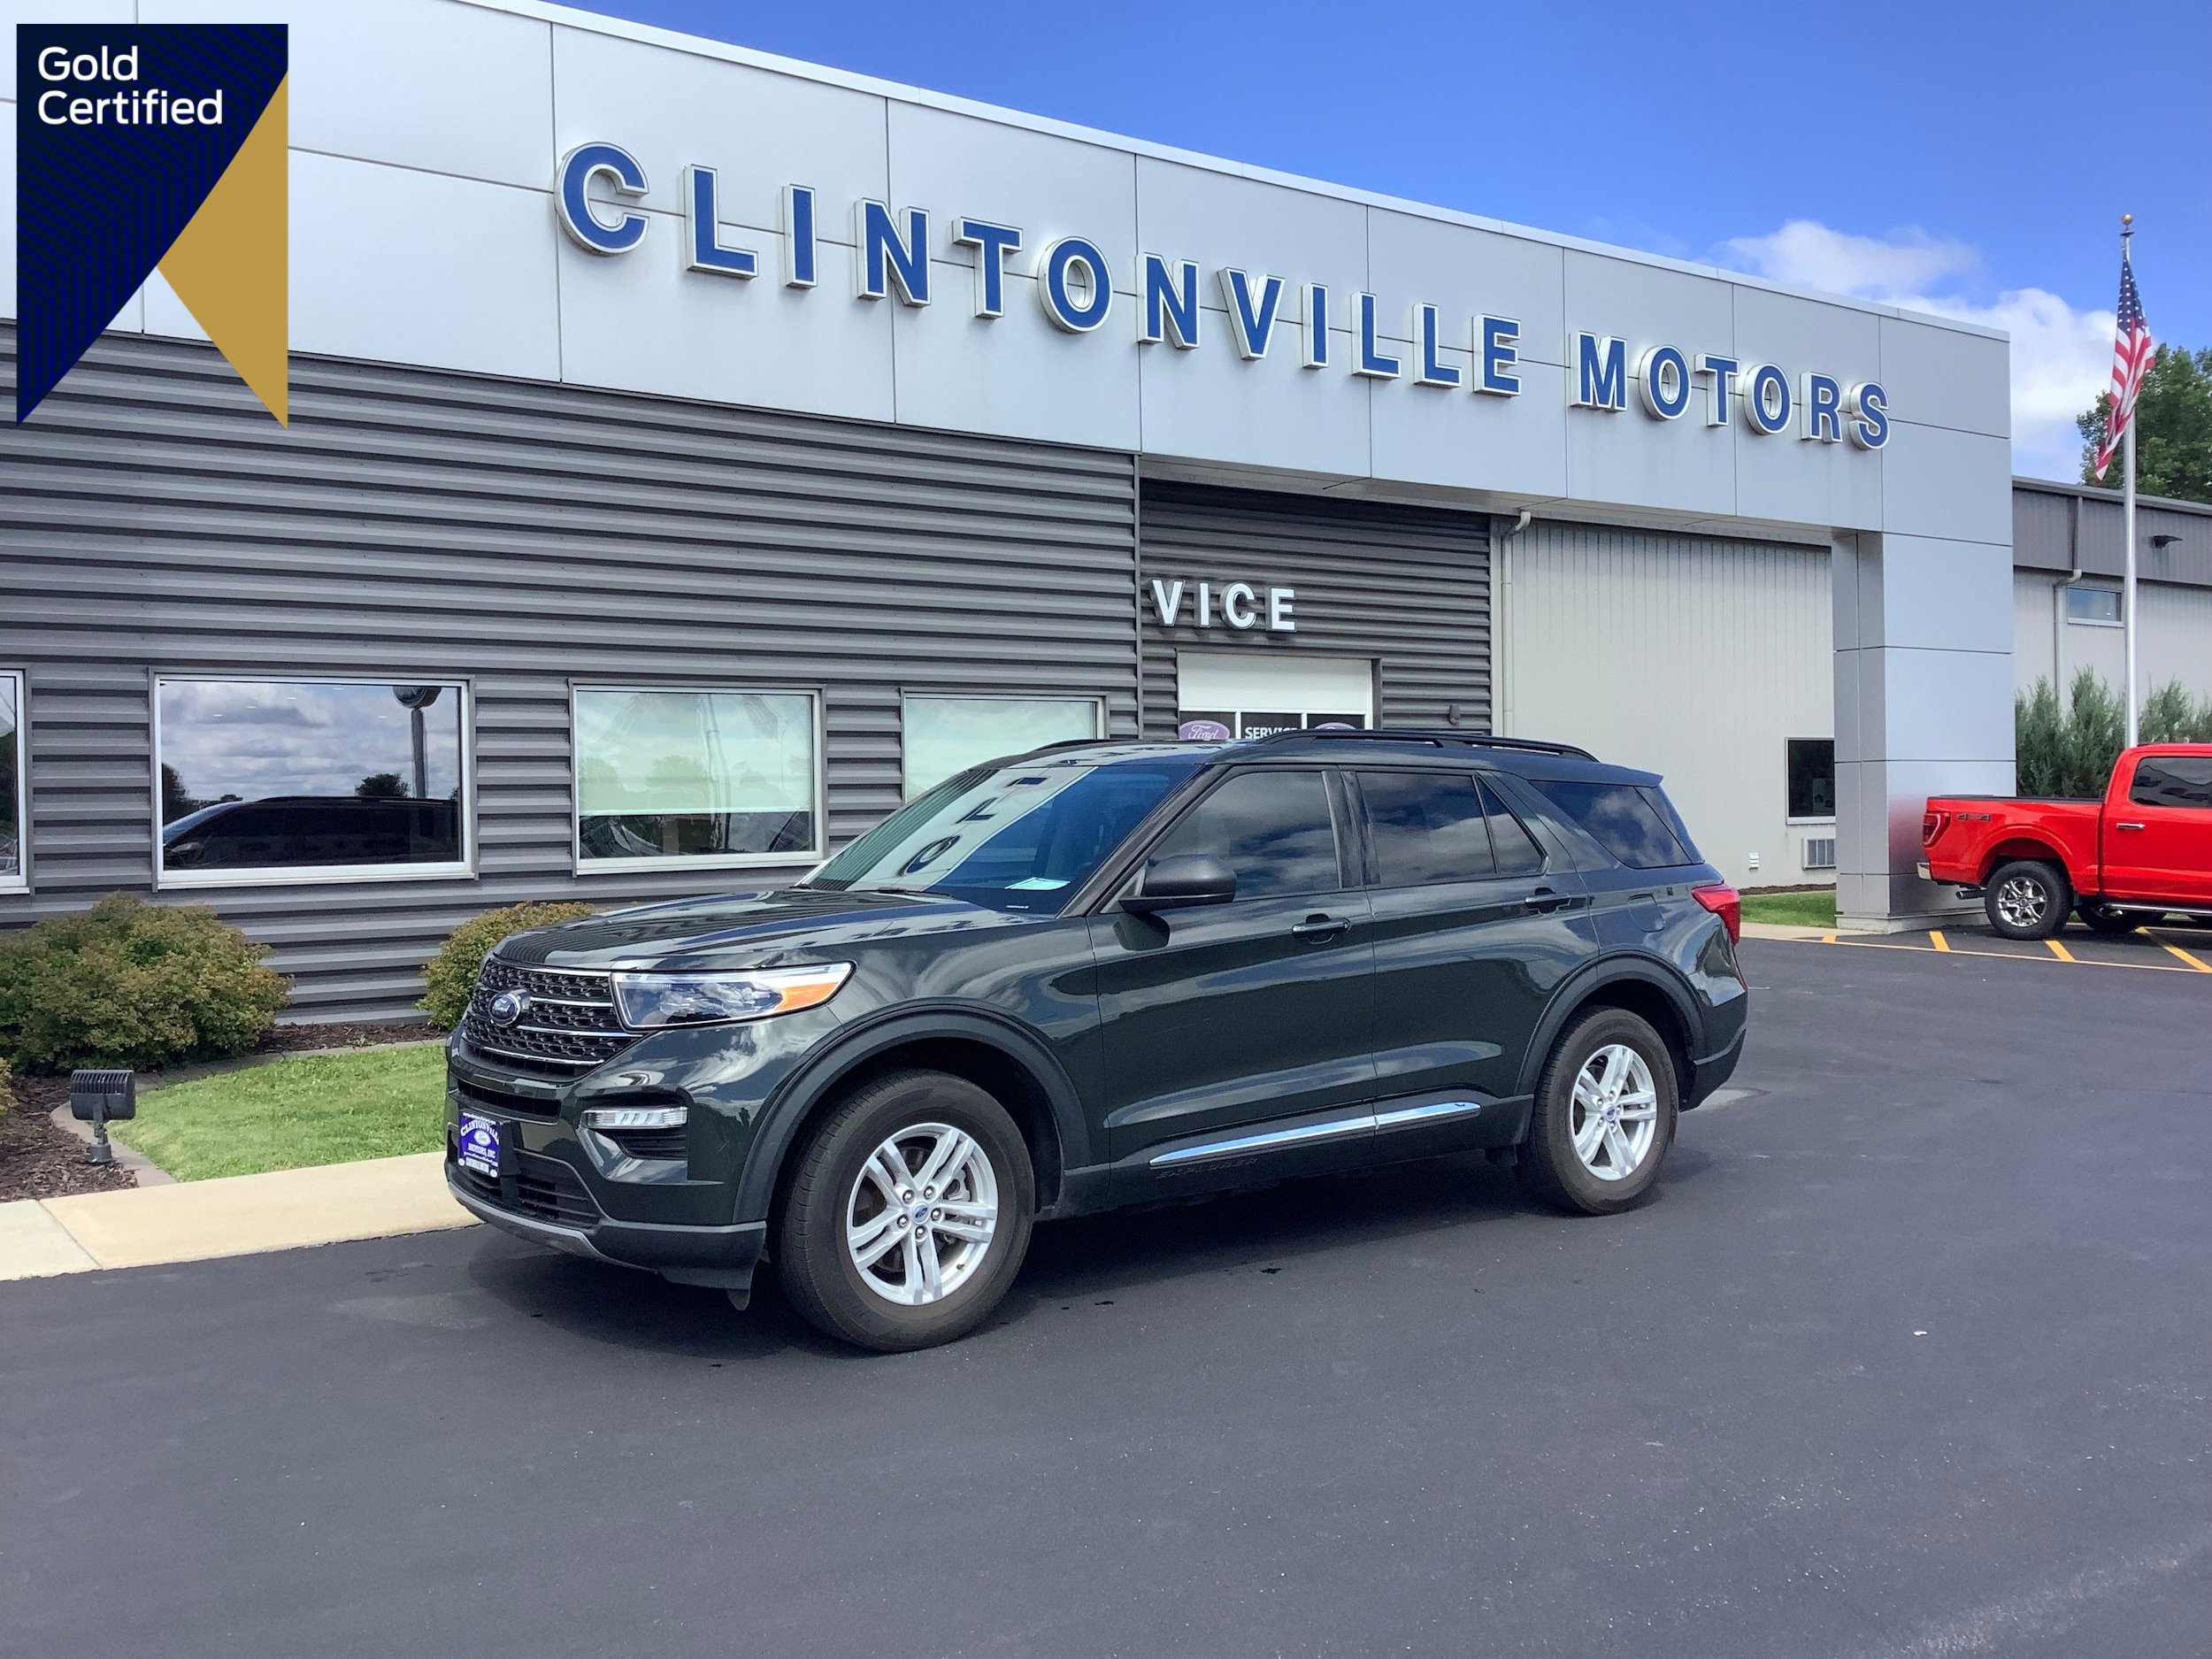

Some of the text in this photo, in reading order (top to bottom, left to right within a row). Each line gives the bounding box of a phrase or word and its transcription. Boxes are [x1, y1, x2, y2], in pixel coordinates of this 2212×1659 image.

[555, 142, 1890, 450] CLINTONVILLE MOTORS
[1151, 579, 1297, 633] VICE
[1187, 724, 1219, 740] Ford
[1244, 726, 1298, 740] SERV
